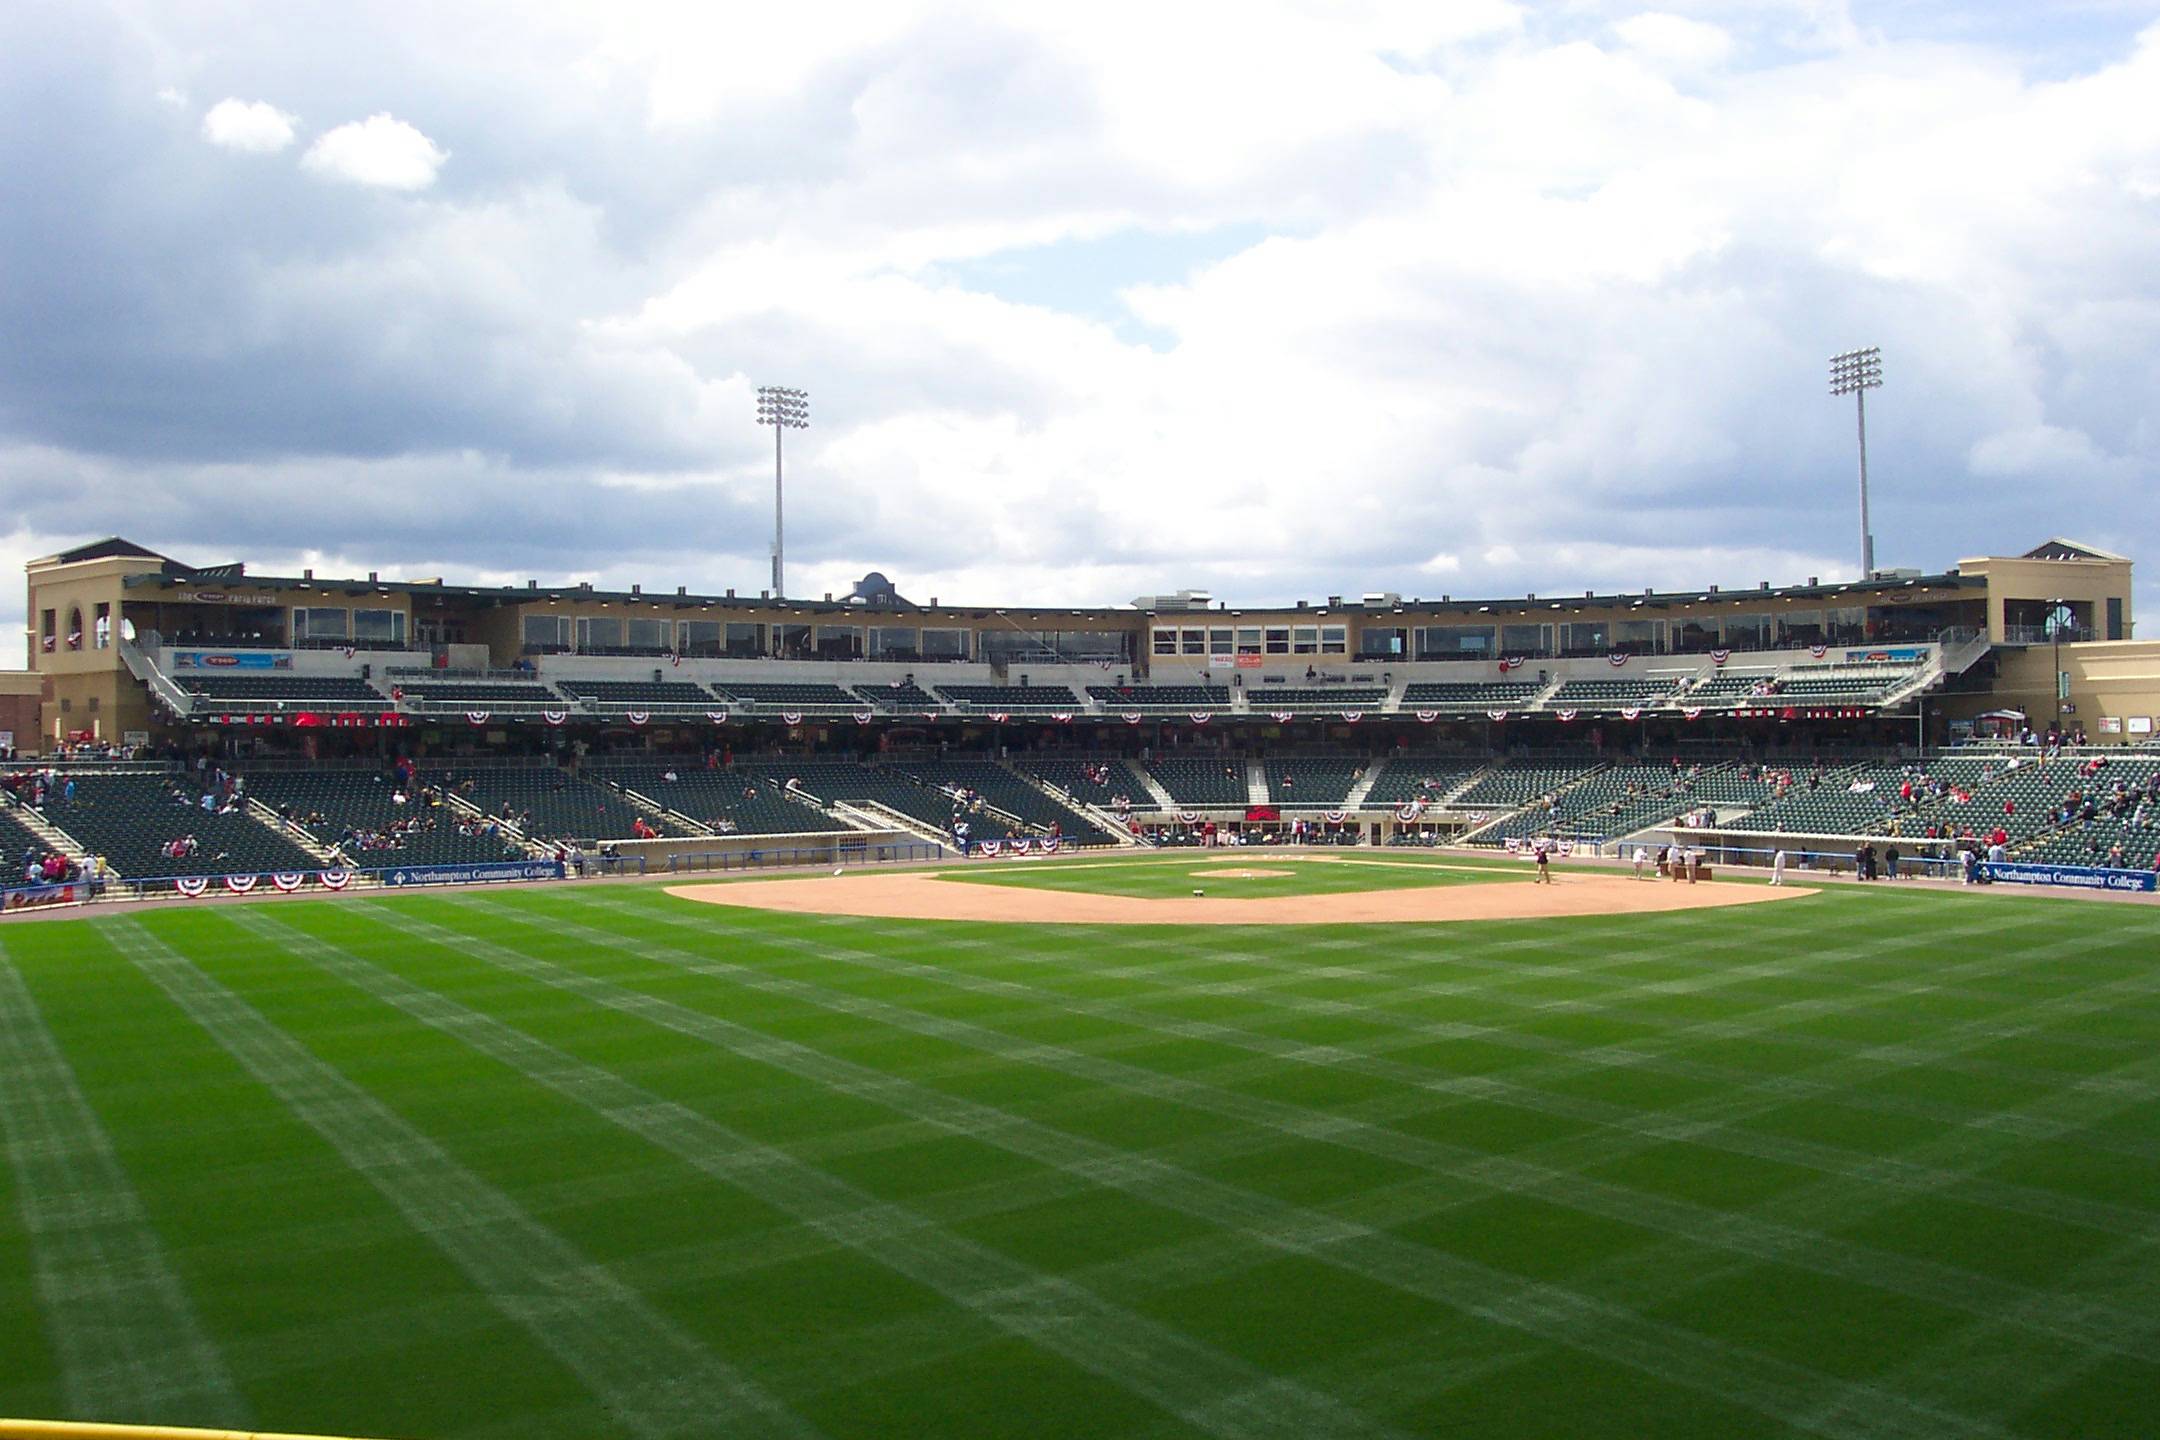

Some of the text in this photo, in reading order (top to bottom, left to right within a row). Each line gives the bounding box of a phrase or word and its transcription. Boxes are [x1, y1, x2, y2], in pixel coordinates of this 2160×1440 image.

[411, 866, 556, 882] Northampton Community College
[1994, 868, 2143, 891] Northampton Community College
